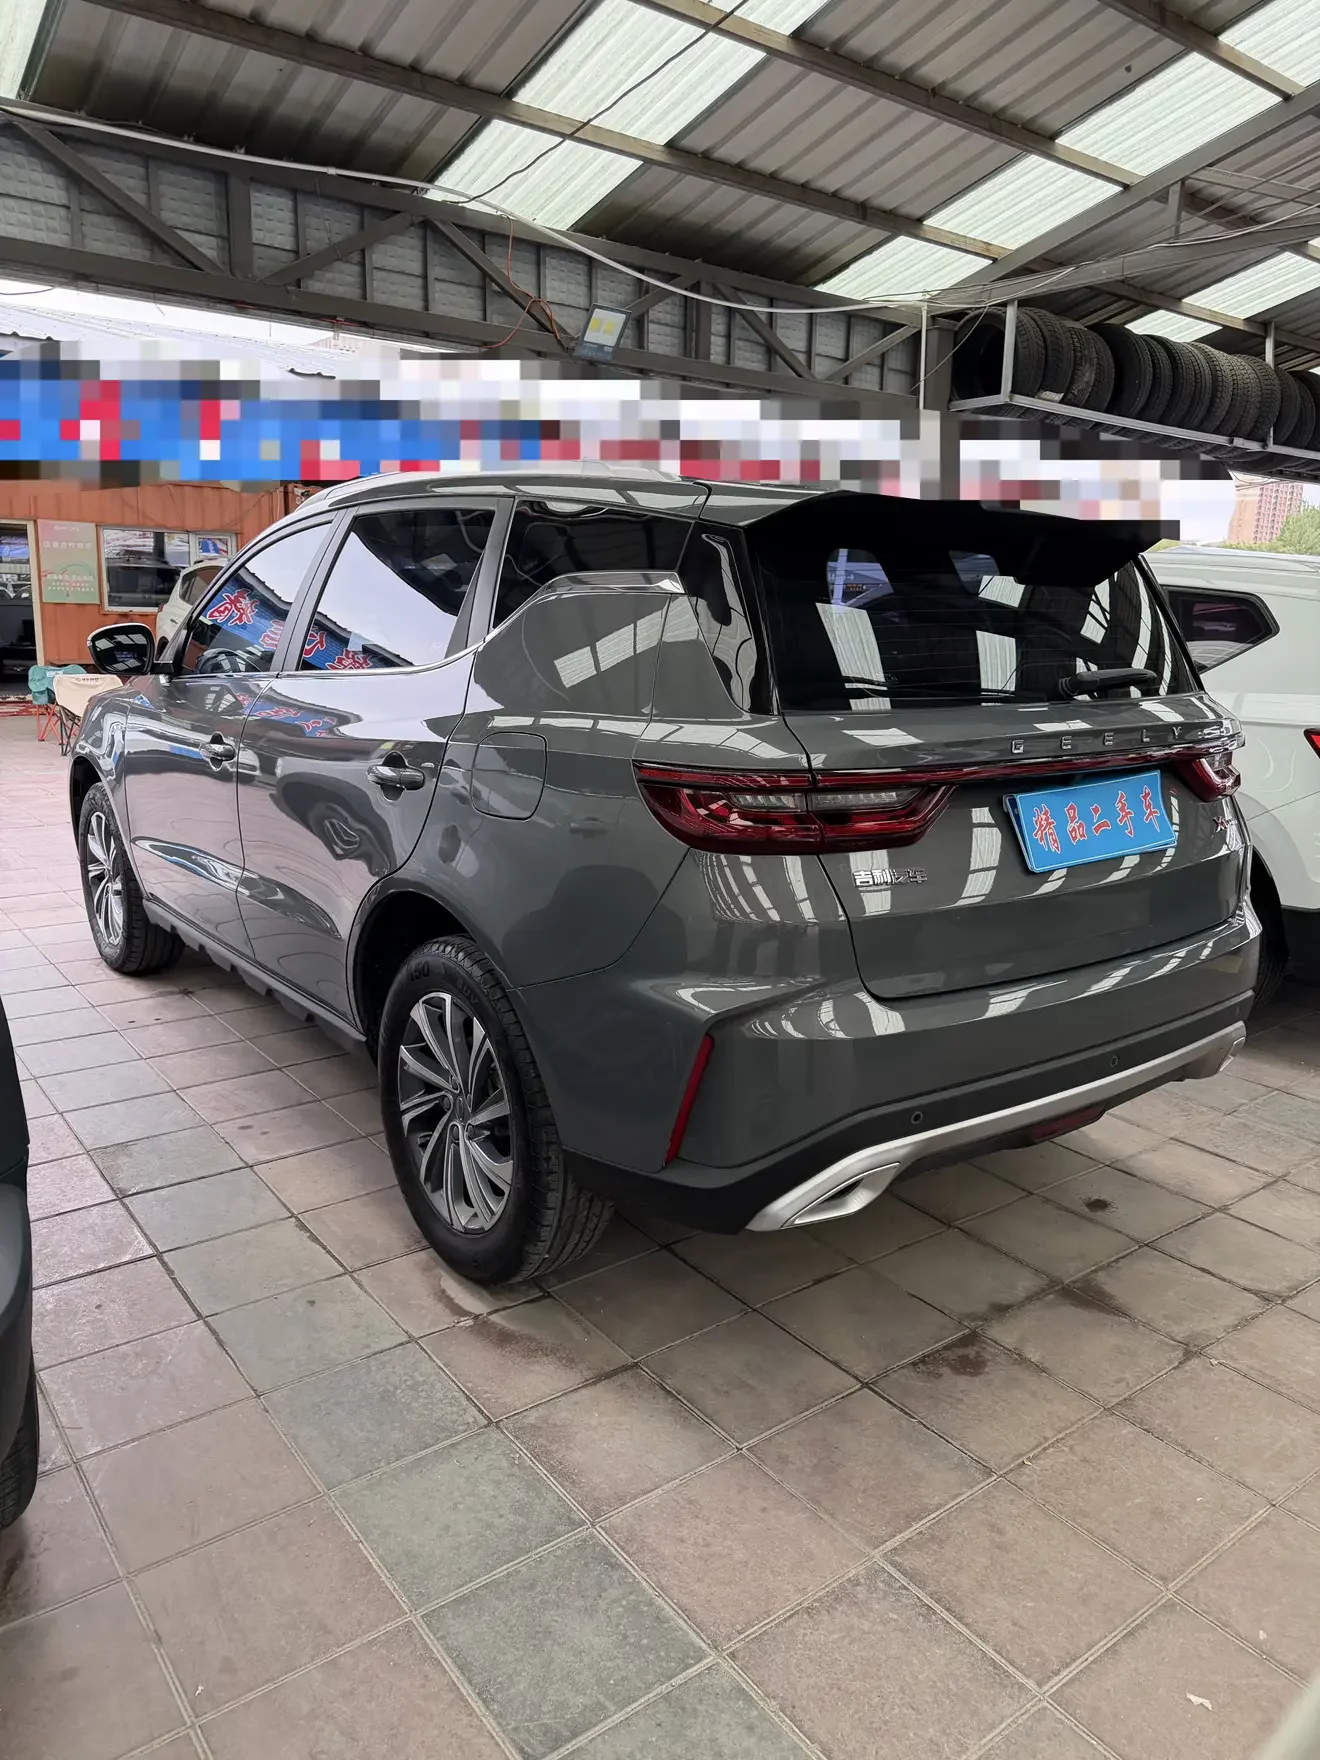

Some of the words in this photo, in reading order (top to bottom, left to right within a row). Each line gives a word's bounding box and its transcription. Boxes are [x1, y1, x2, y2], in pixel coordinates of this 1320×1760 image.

[1011, 726, 1182, 754] GEELY
[1033, 785, 1160, 854] 精品二手车
[853, 868, 928, 887] 吉利汽车
